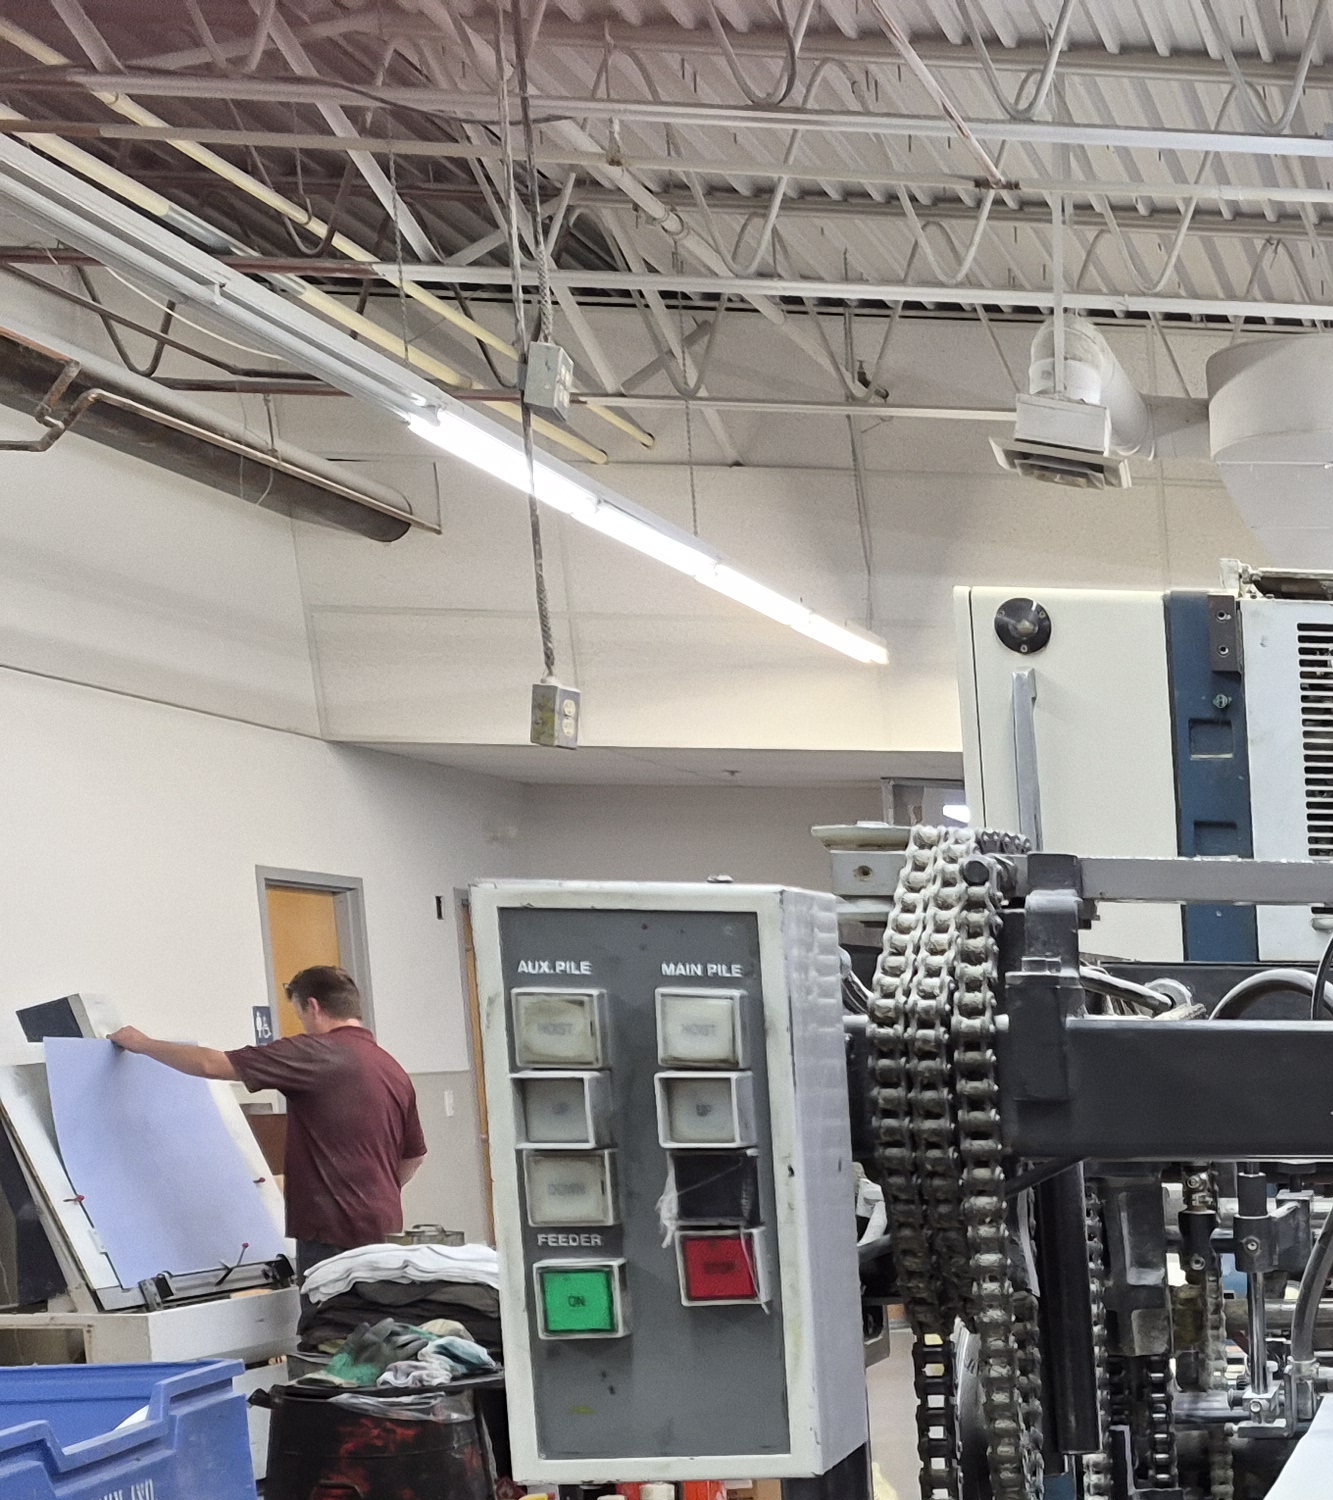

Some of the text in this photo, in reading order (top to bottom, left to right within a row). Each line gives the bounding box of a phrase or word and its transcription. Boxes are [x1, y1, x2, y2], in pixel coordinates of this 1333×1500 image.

[661, 962, 743, 978] MAIN PILE
[537, 1234, 603, 1247] FEEDER
[568, 1295, 585, 1307] ON
